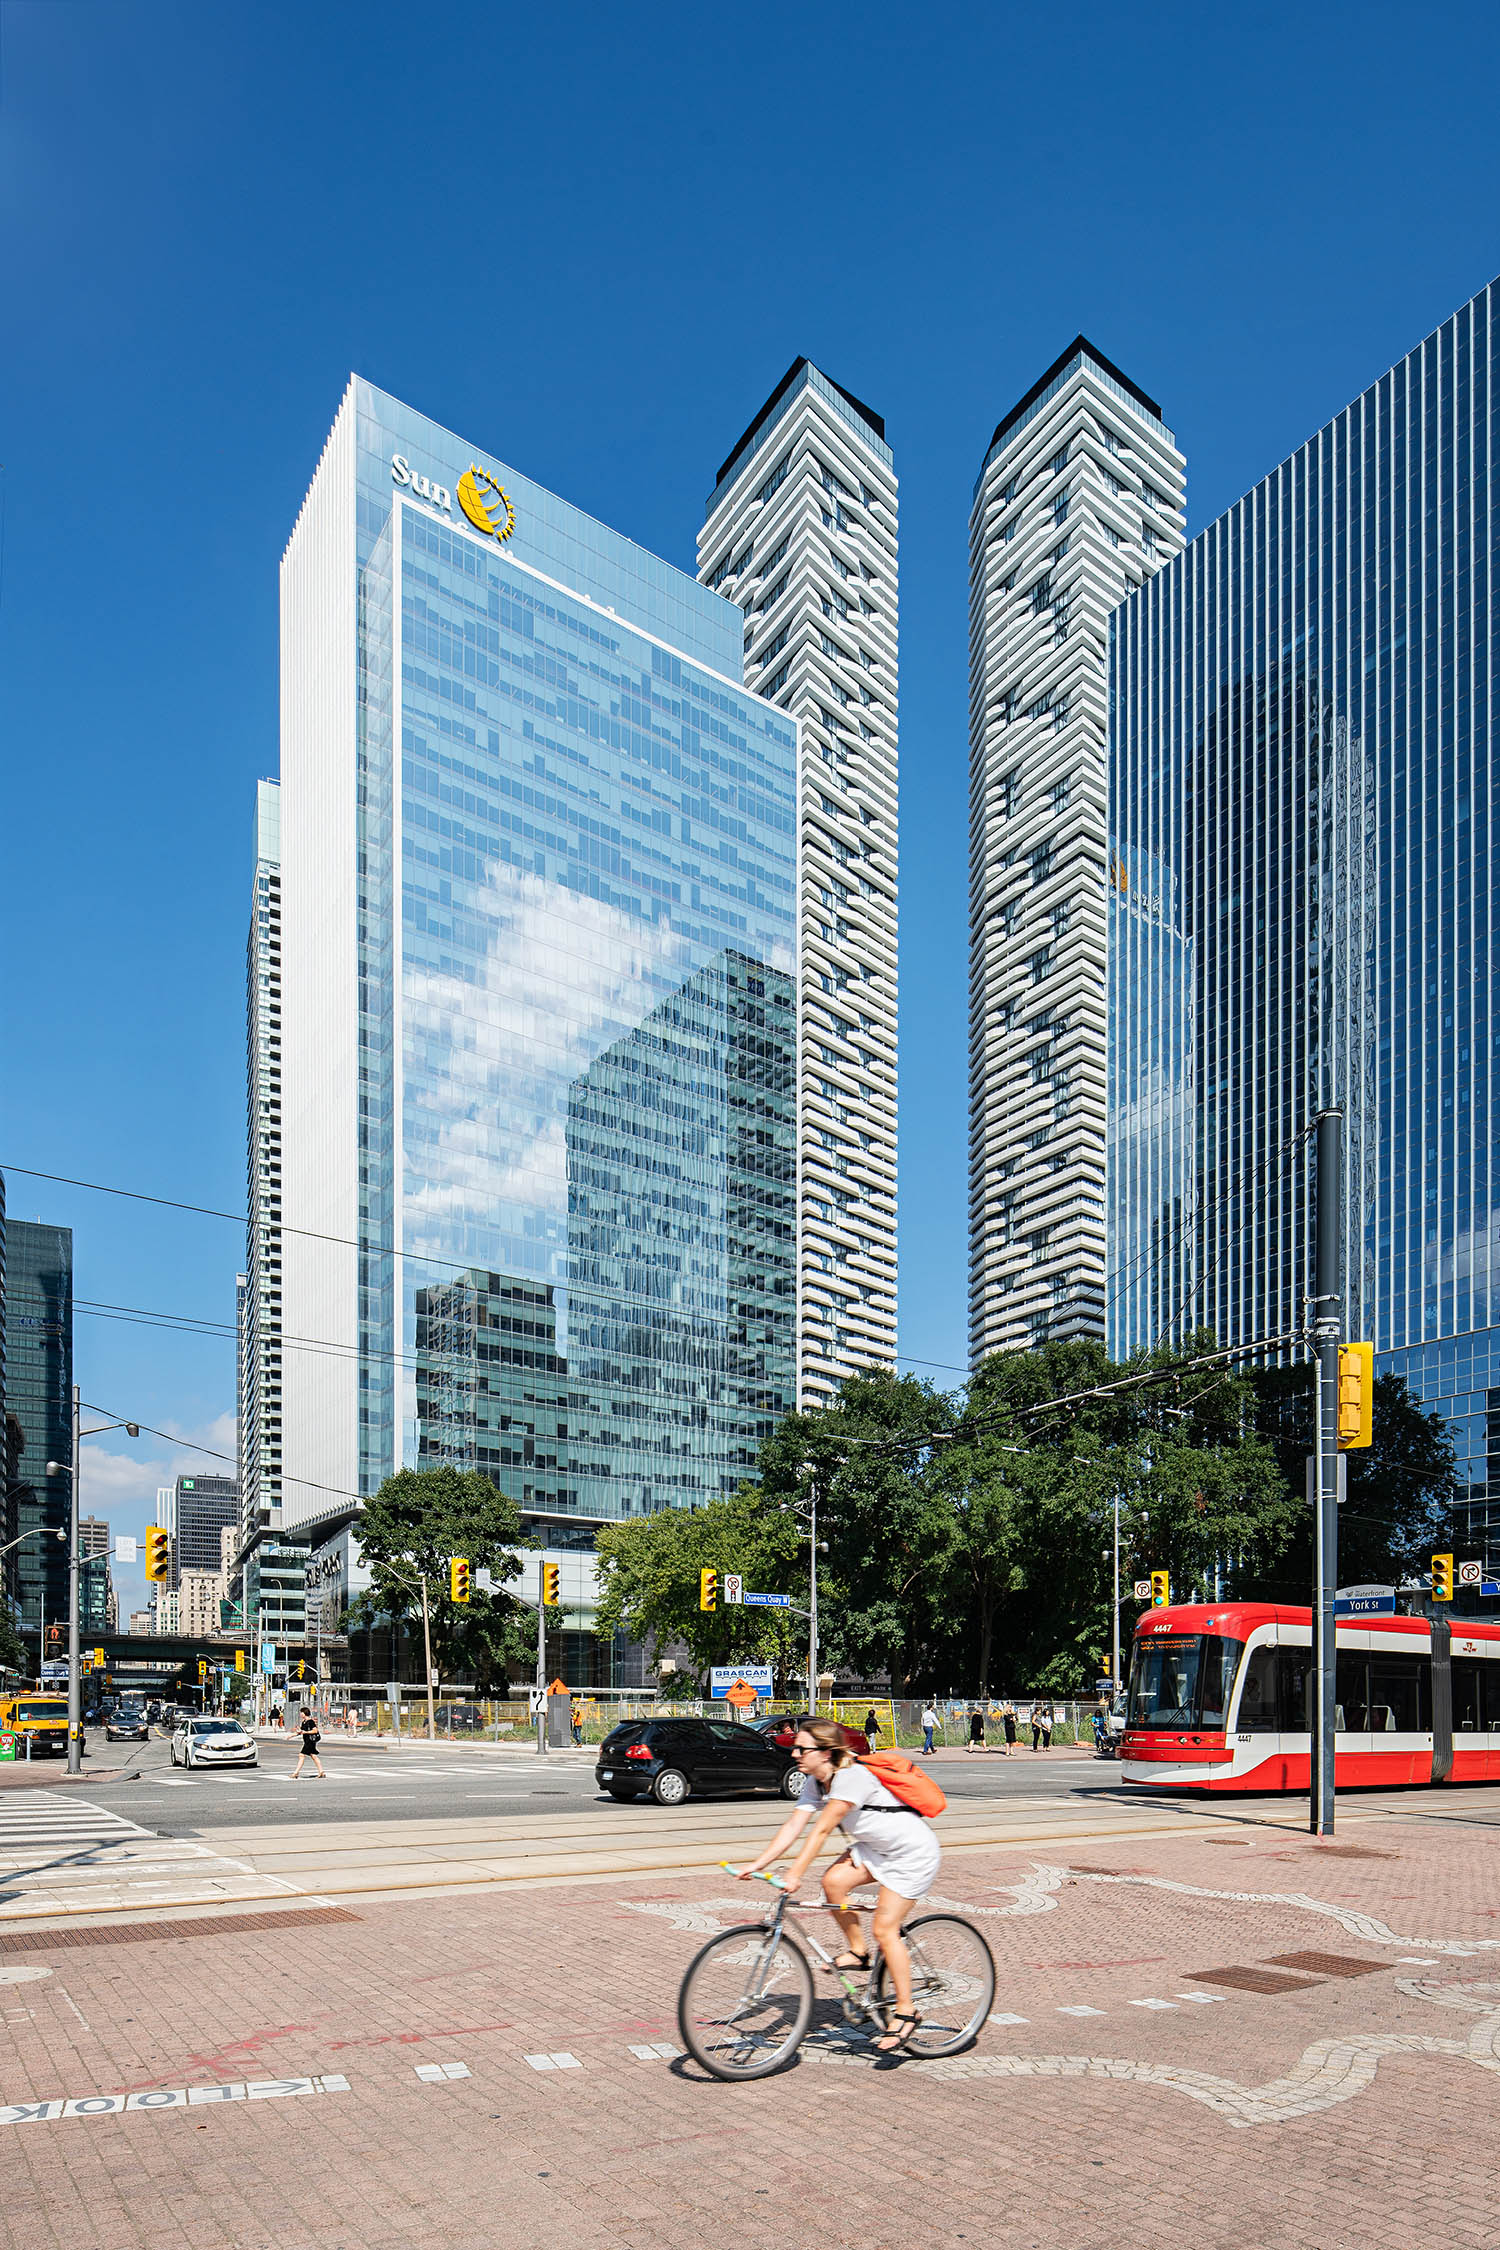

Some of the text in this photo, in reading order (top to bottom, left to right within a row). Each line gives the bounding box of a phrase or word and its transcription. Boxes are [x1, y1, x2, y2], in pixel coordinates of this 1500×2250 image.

[391, 454, 453, 511] Sun
[184, 1480, 194, 1489] TD
[745, 1594, 767, 1603] Queens
[767, 1595, 782, 1606] Quay
[1349, 1600, 1379, 1611] York St
[1153, 1624, 1173, 1632] 4447
[715, 1669, 768, 1677] GRASCAN
[1237, 1734, 1252, 1743] 4447
[8, 2085, 234, 2123] LOOK
